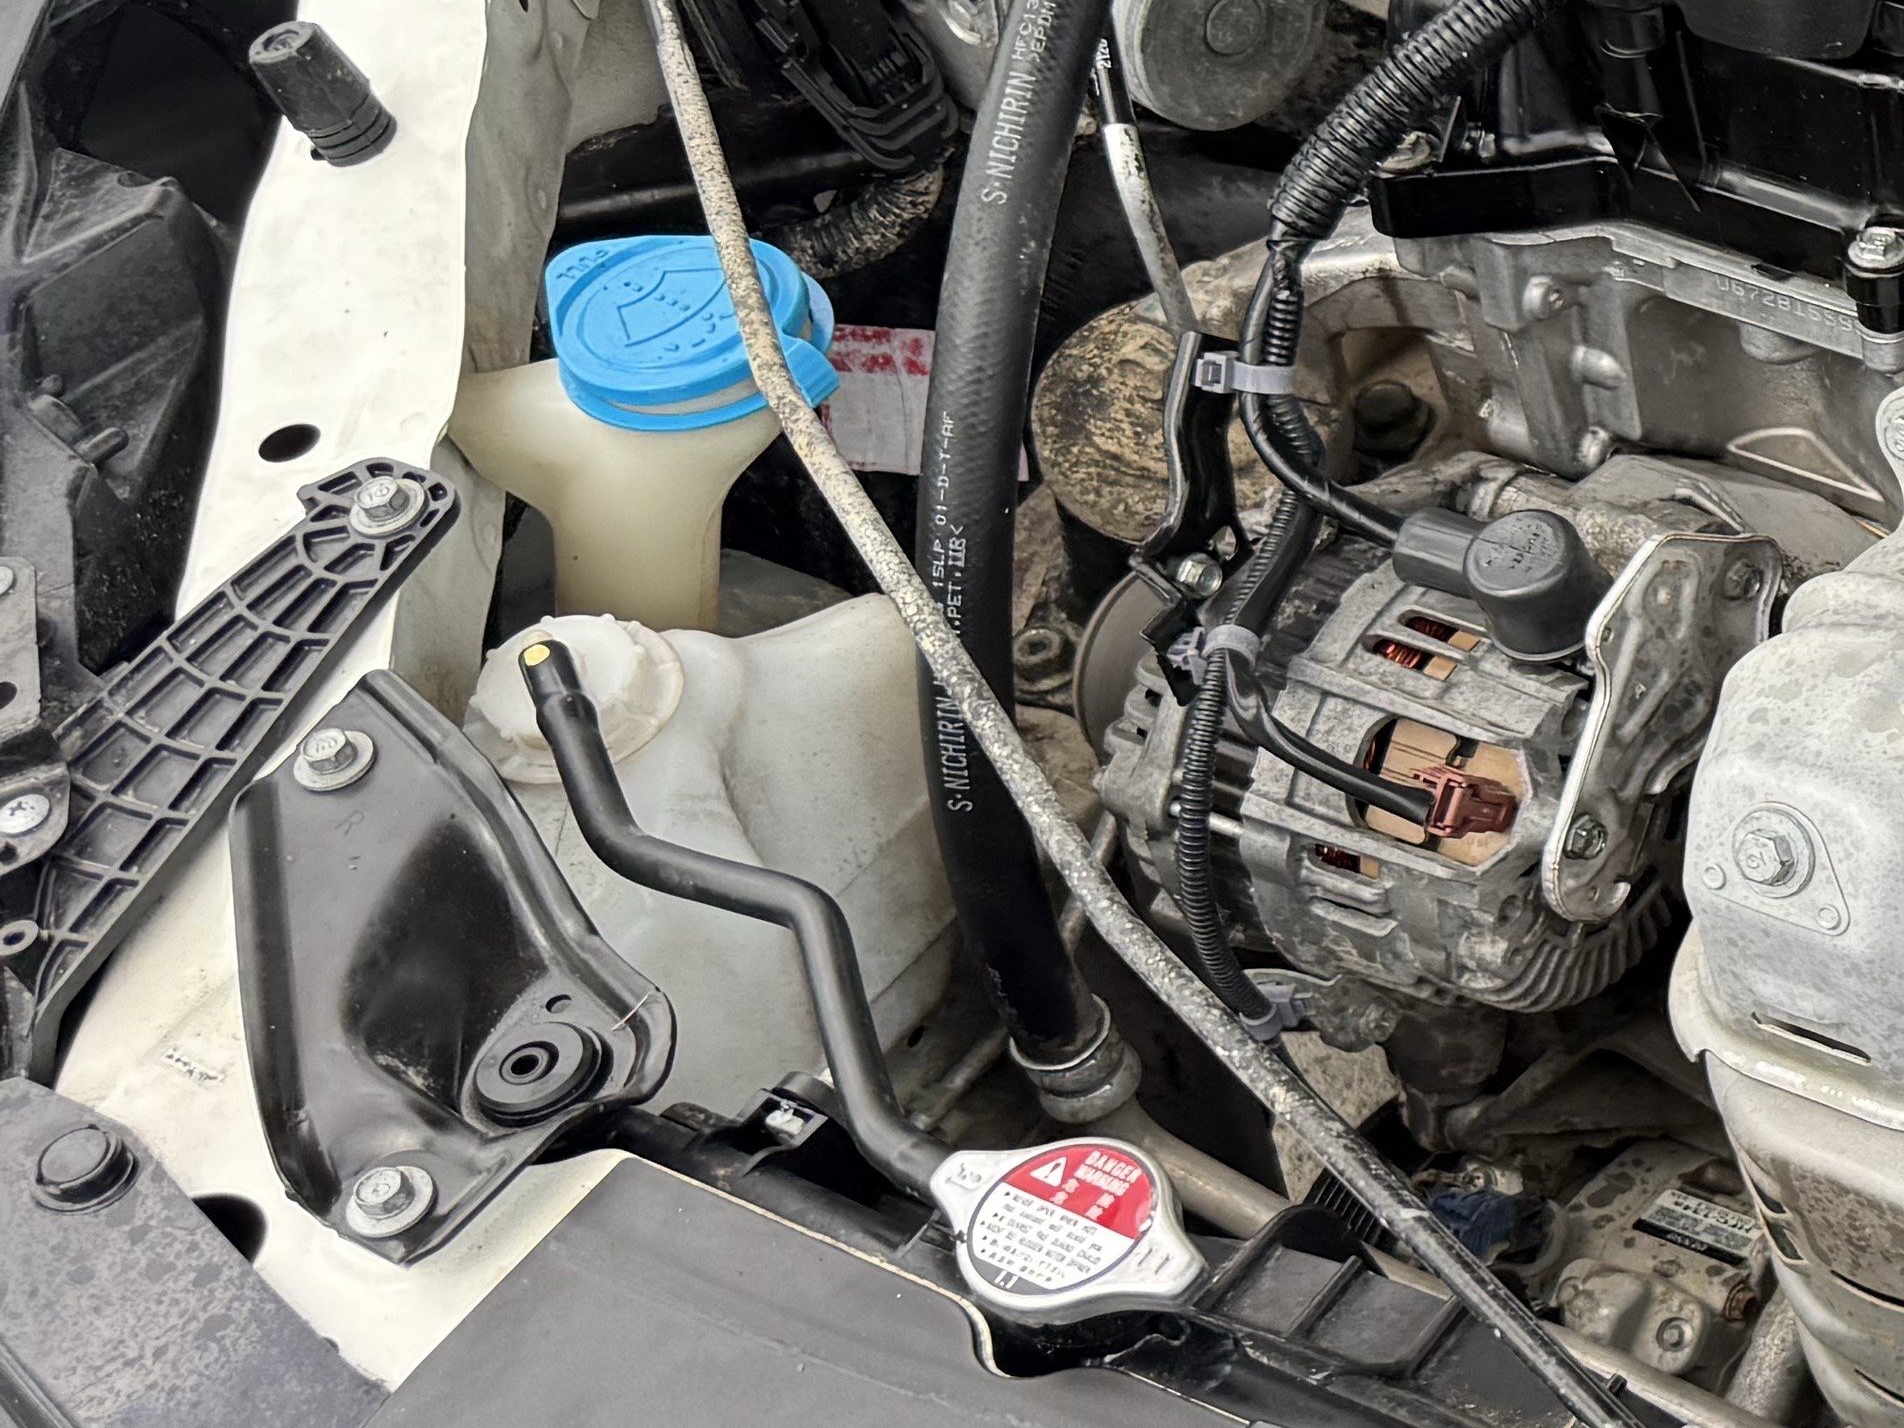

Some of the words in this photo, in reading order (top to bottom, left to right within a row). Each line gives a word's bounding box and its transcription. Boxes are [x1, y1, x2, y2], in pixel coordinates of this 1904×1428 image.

[931, 538, 945, 587] 15LP
[1084, 1150, 1143, 1184] DANGER
[993, 1269, 1020, 1289] 1.1
